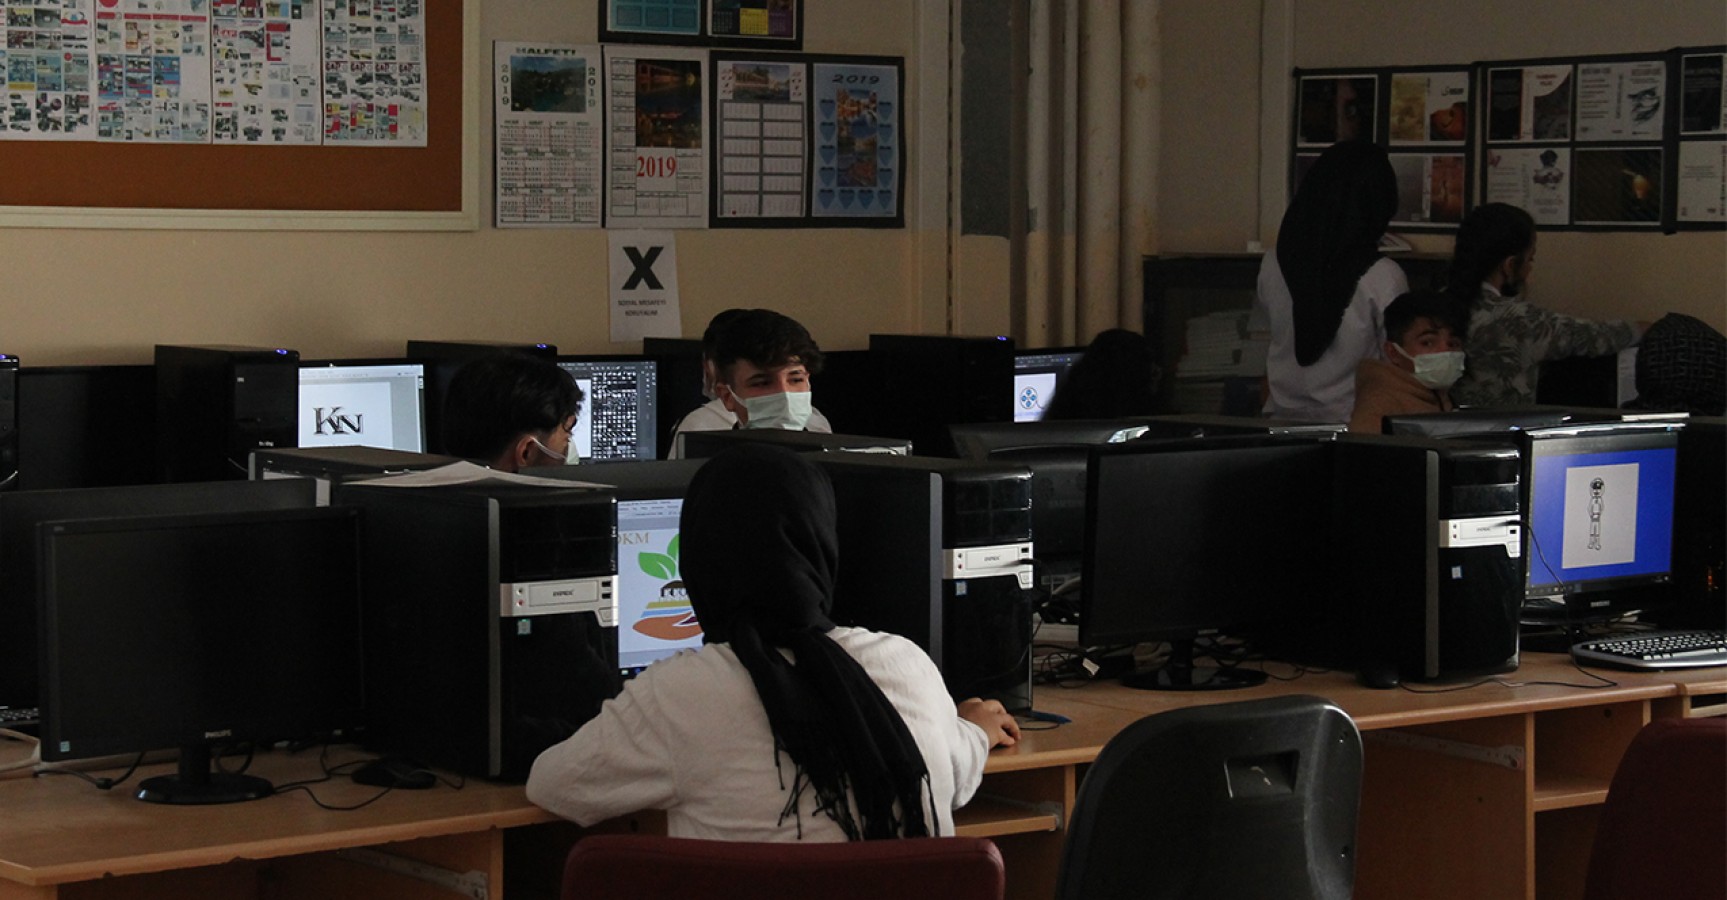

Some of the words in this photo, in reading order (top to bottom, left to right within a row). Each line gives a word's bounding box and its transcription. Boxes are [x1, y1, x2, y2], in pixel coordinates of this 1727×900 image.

[832, 74, 880, 85] 2019
[637, 156, 676, 177] 2019
[622, 246, 664, 290] X
